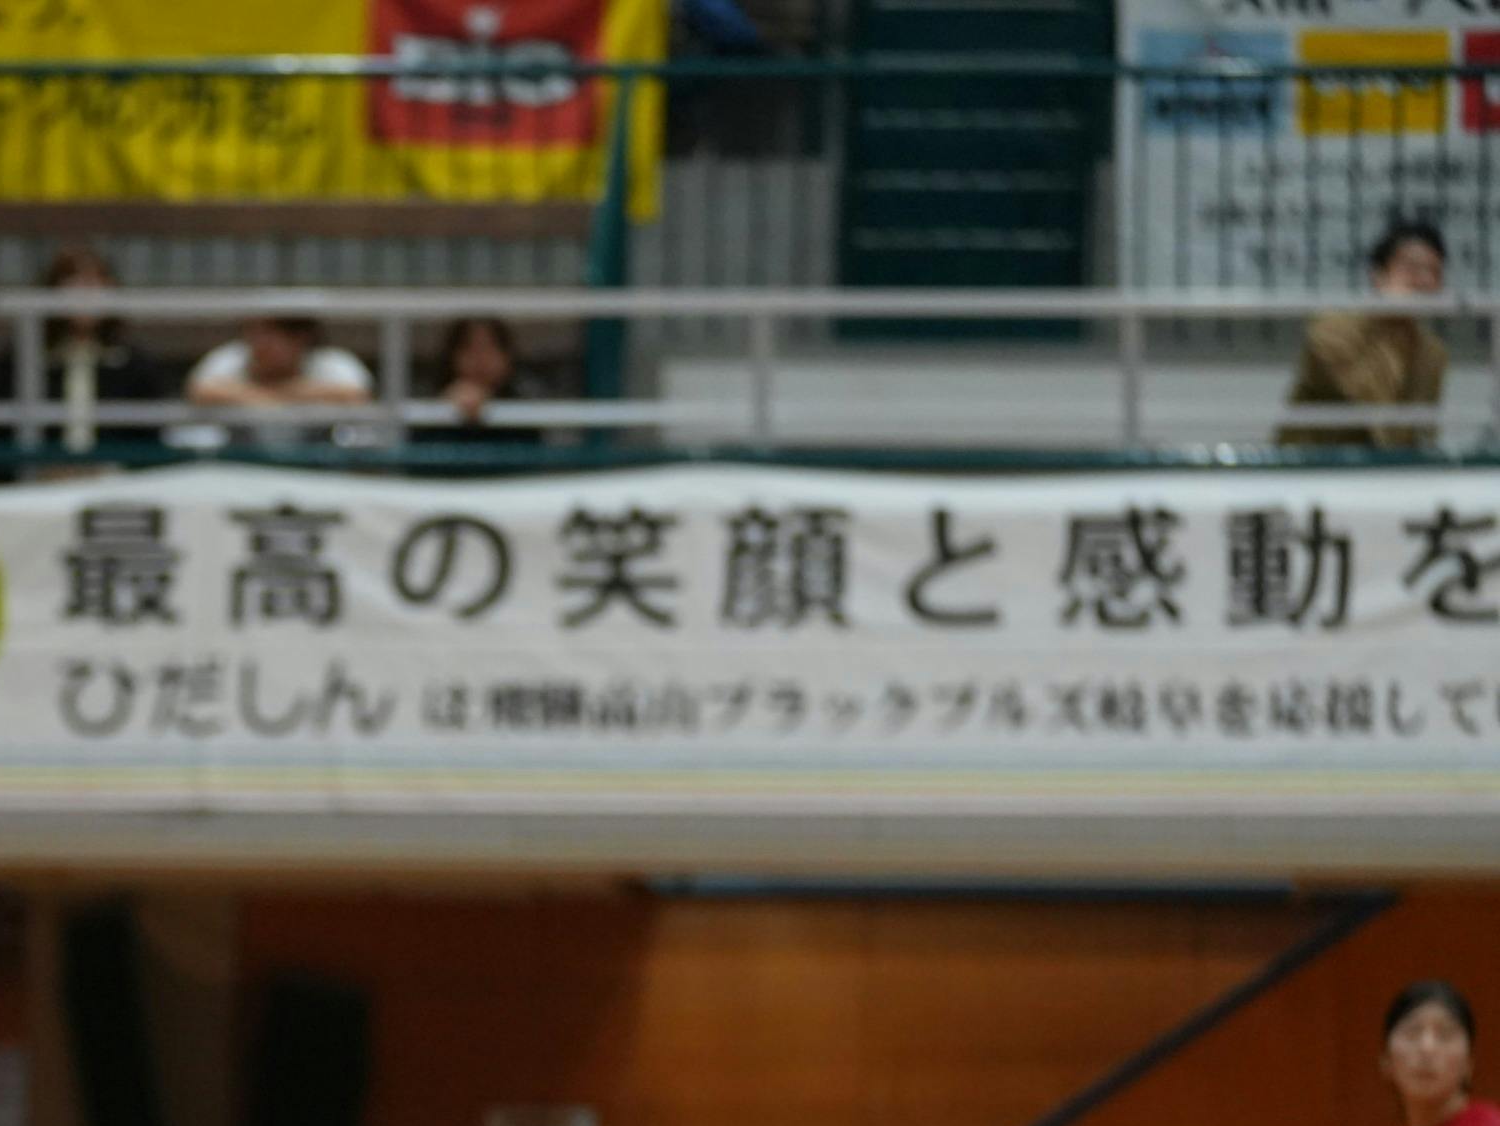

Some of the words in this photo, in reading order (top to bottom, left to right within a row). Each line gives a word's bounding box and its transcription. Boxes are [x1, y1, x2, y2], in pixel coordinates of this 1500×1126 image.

[62, 500, 1500, 630] 最高の笑顔と感動を
[60, 657, 396, 738] ひだしん
